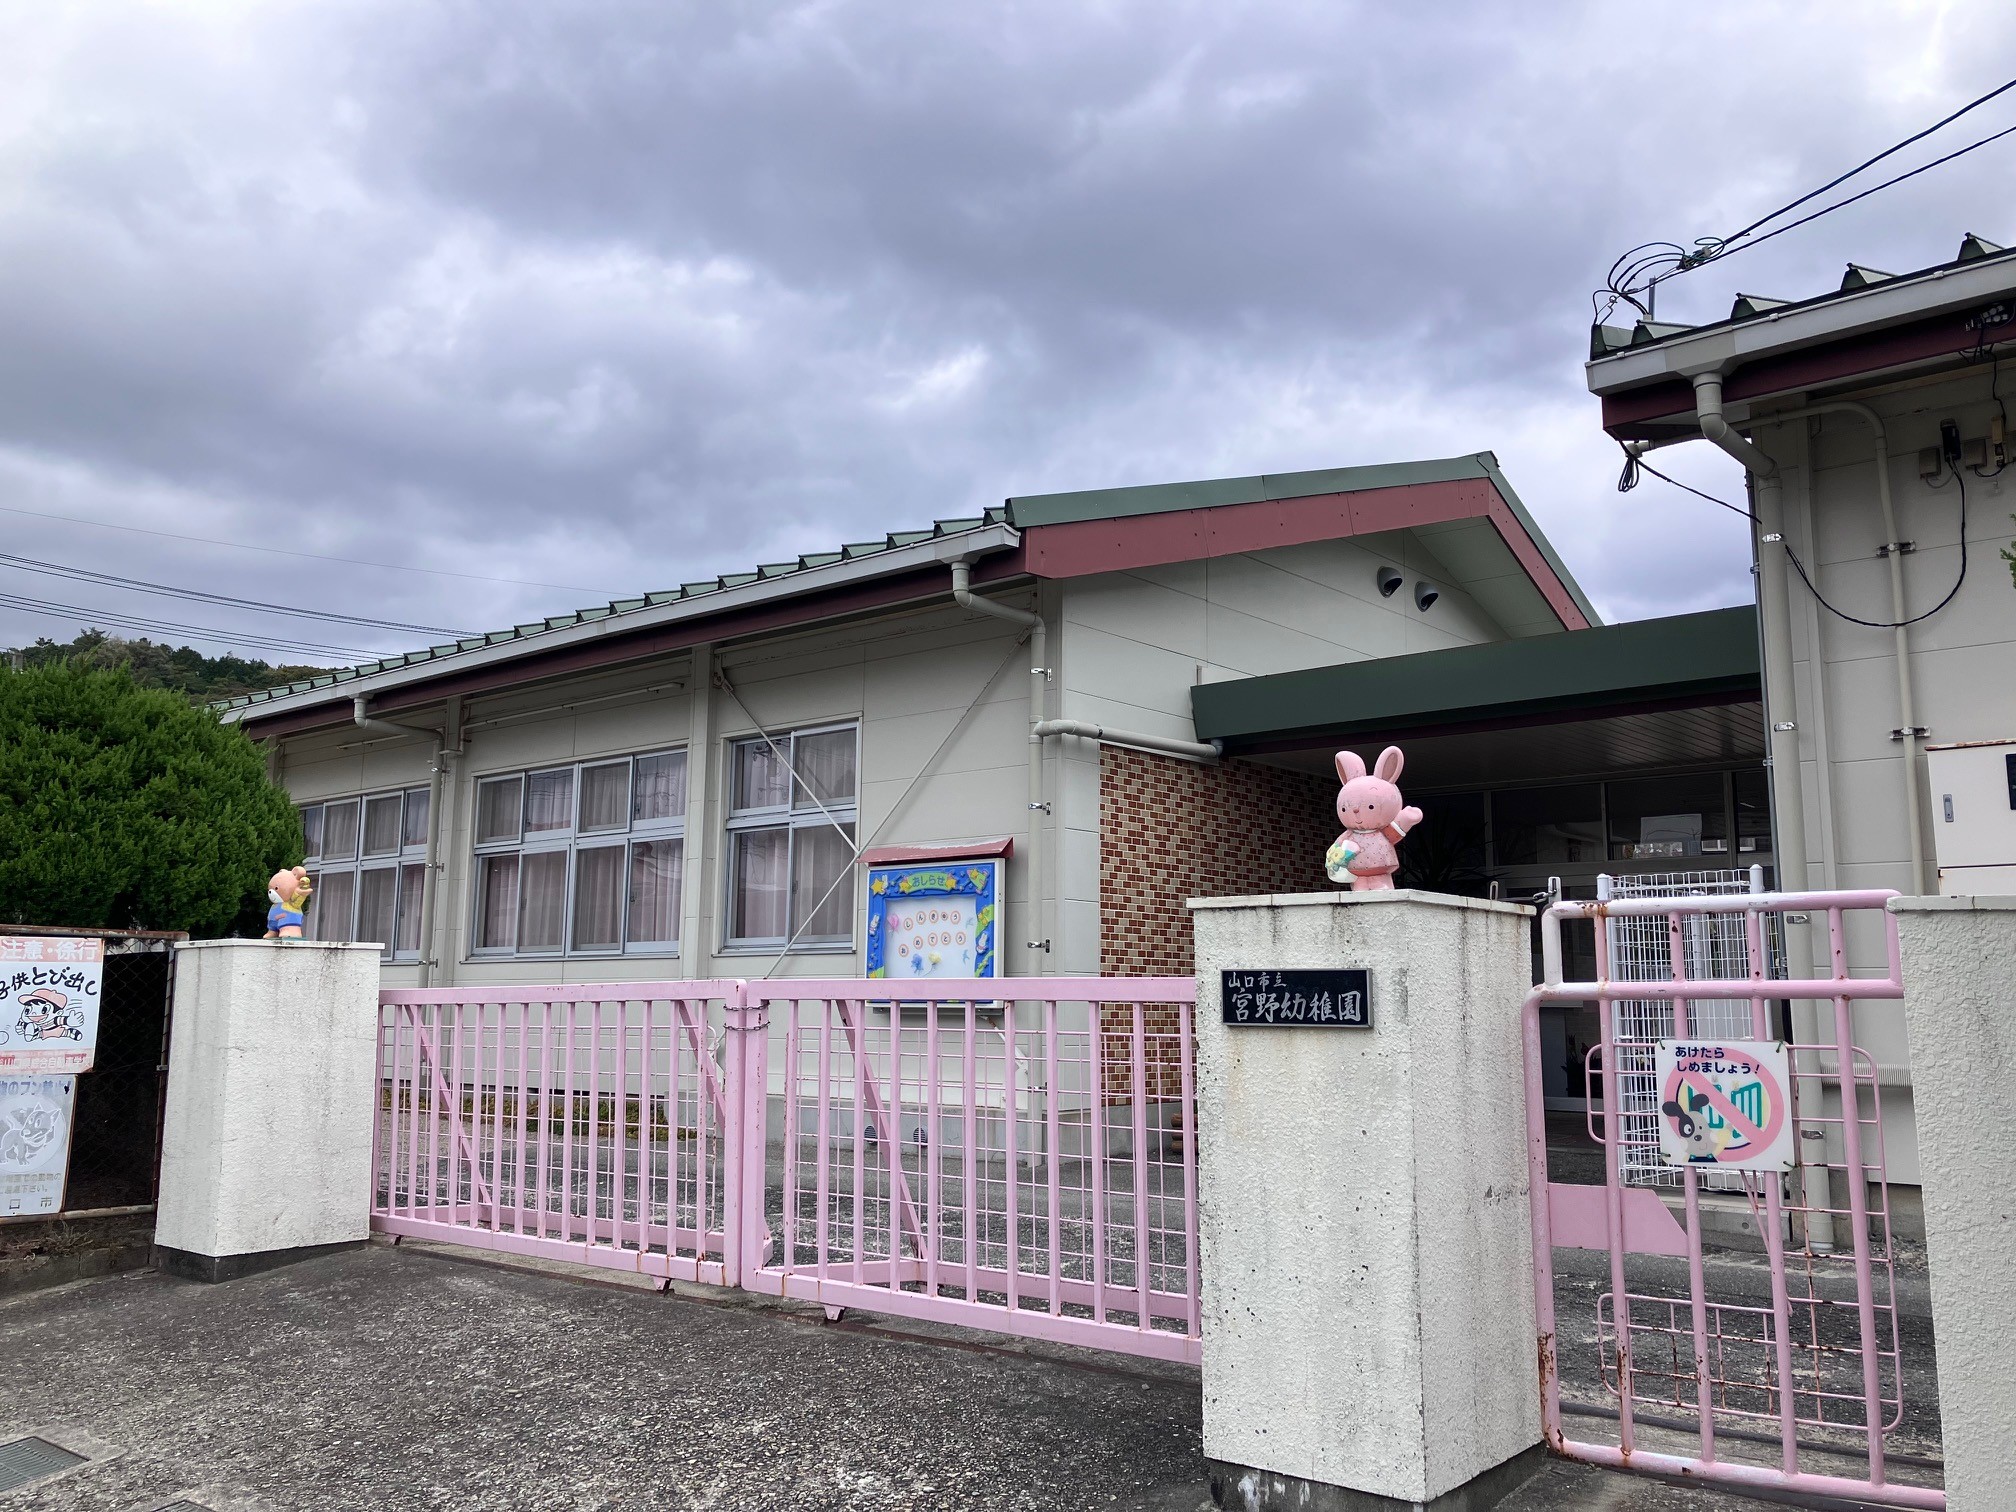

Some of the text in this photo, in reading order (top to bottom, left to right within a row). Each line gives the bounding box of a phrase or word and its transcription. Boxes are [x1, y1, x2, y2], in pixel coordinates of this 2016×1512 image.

[912, 875, 945, 887] おしらせ
[900, 935, 964, 955] おめでとう
[1228, 971, 1287, 992] 山口市立
[1231, 987, 1361, 1023] 宮野幼稚園
[1675, 1046, 1725, 1059] あけたら
[1676, 1061, 1760, 1075] しめましょう！
